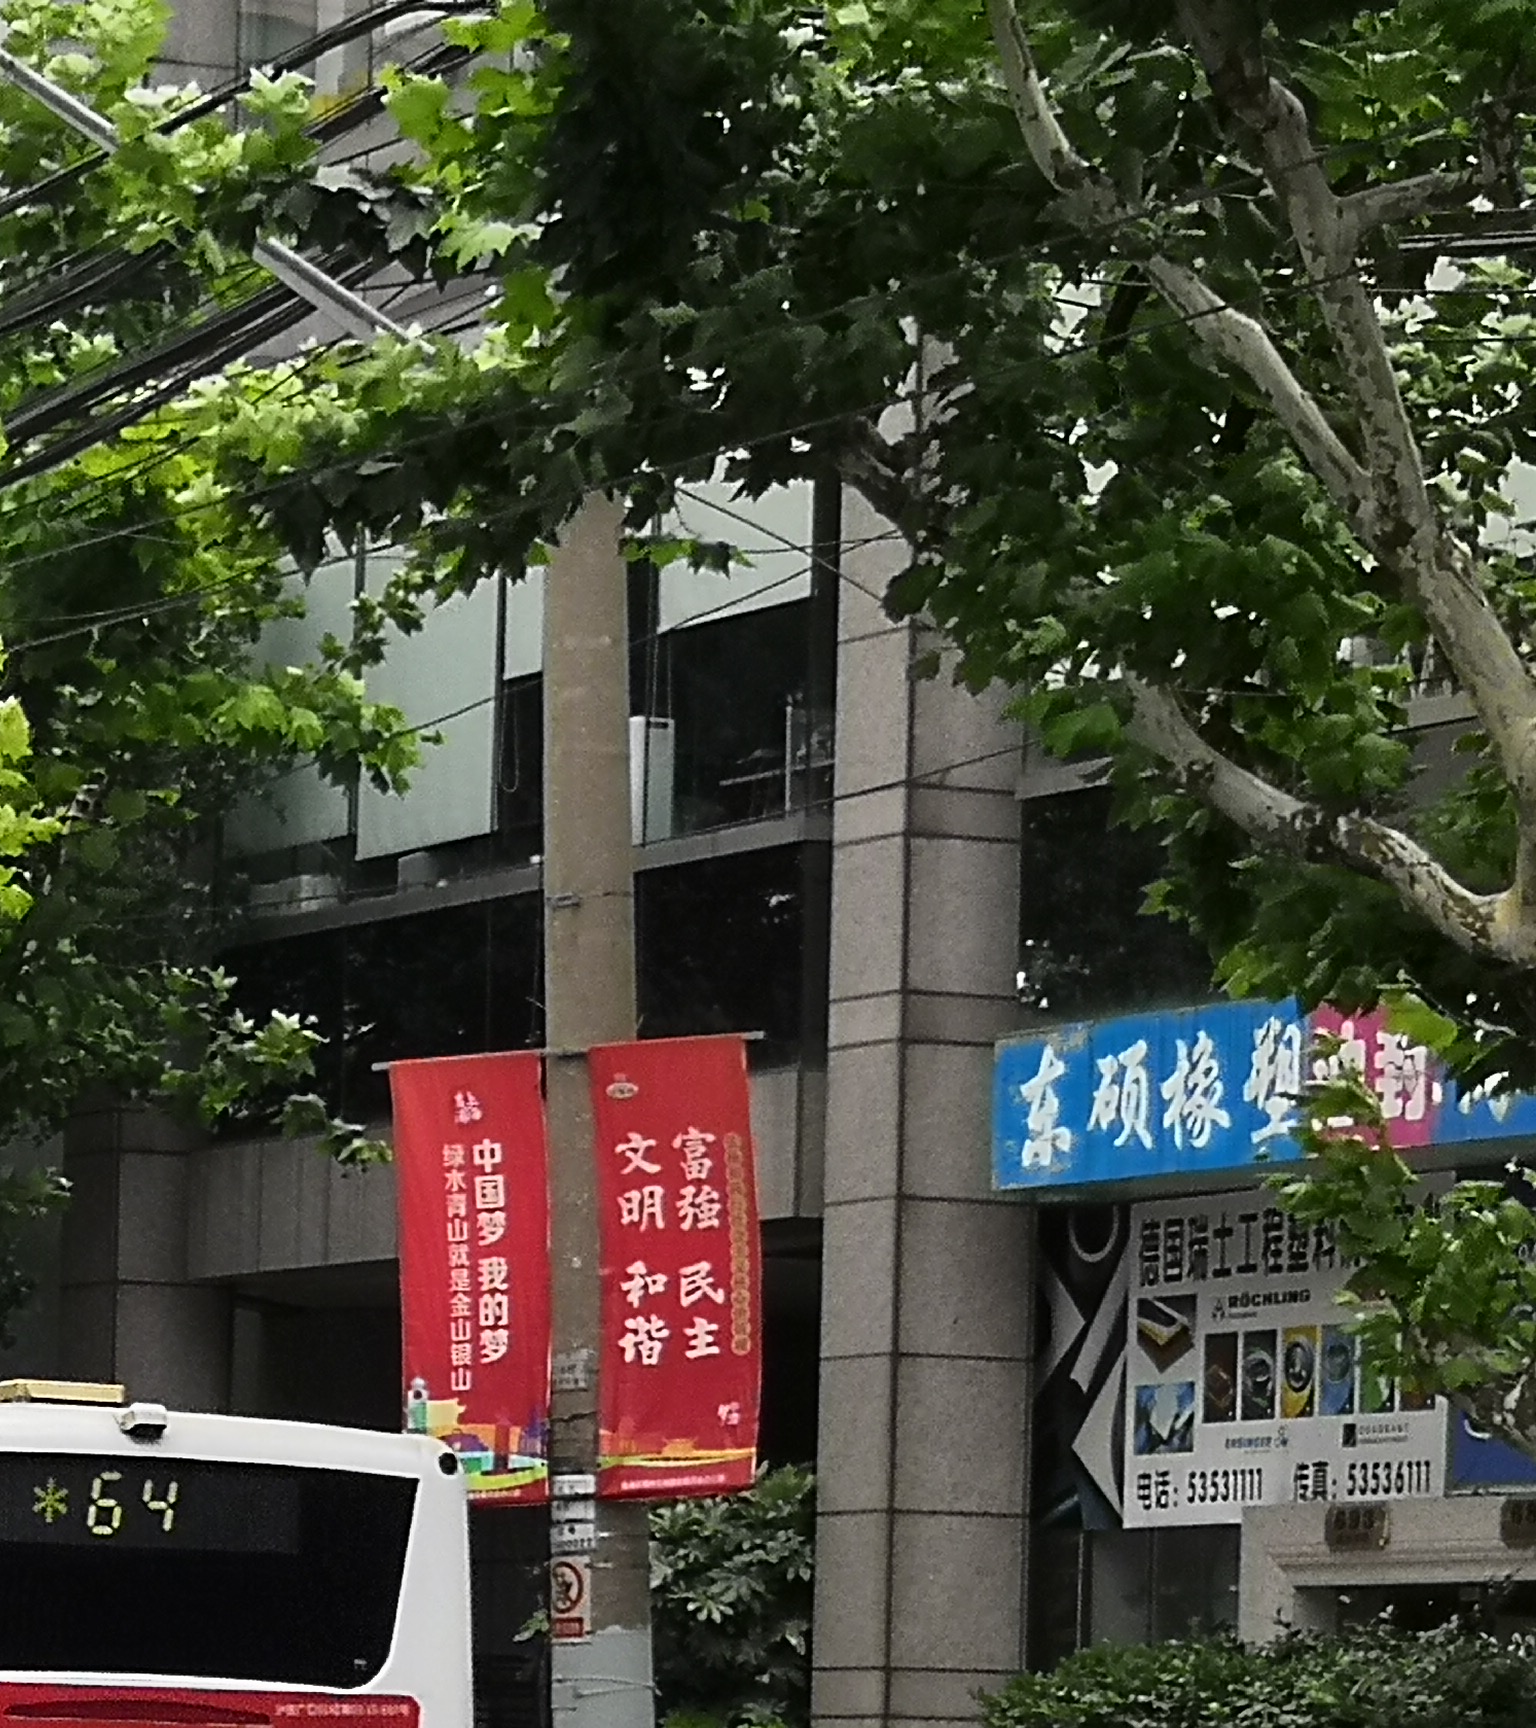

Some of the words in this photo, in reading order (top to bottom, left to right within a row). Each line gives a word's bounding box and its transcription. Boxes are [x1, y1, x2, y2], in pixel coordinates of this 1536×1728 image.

[472, 1138, 507, 1246] 中国梦
[614, 1132, 665, 1232] 文明
[477, 1256, 508, 1364] 我的梦
[617, 1260, 670, 1365] 和谐
[678, 1260, 725, 1359] 民主
[85, 1470, 180, 1536] 64
